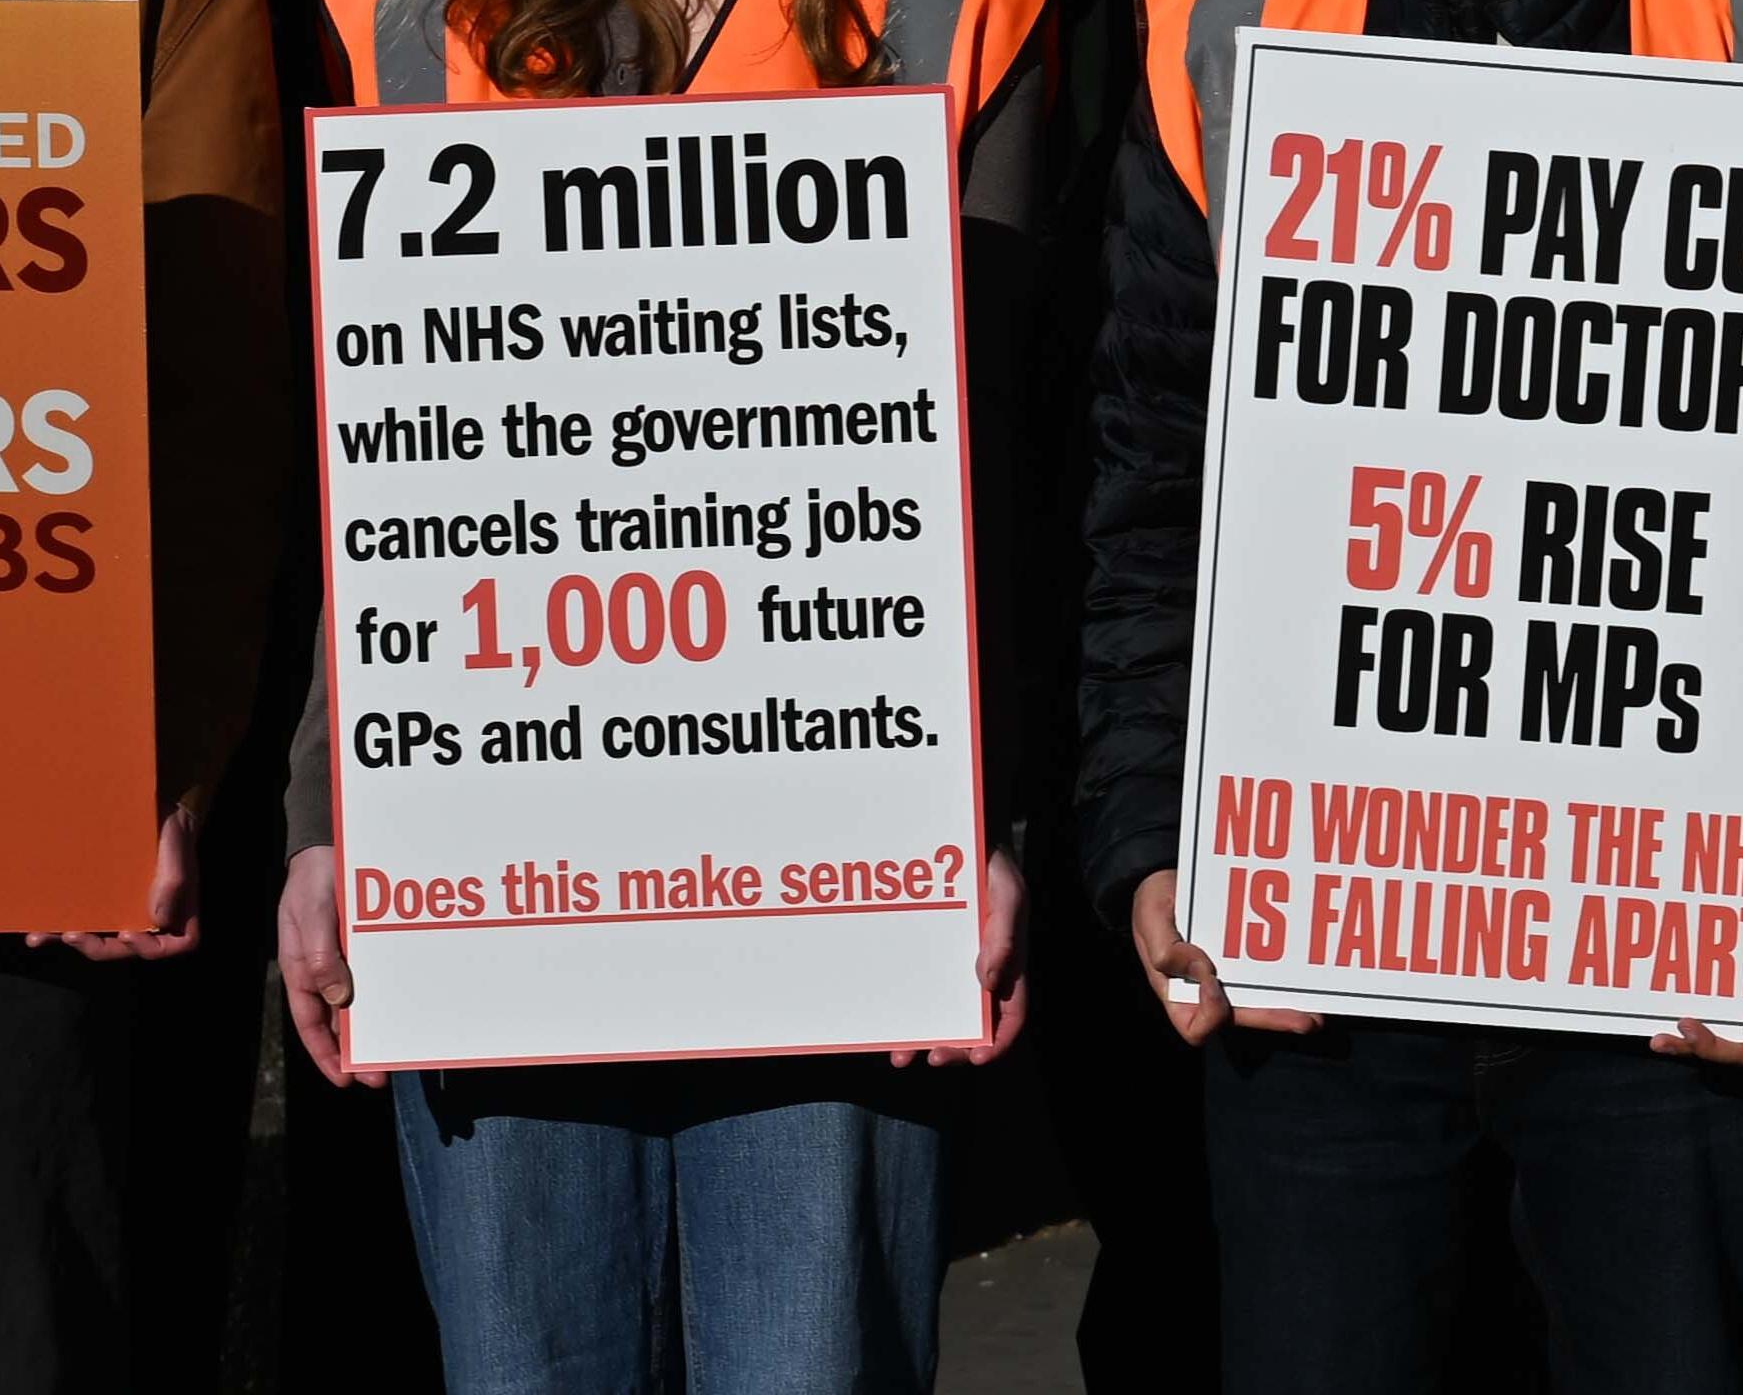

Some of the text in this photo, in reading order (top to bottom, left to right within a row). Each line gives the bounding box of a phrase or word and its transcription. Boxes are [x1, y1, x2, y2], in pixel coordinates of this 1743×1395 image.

[0, 112, 86, 169] ED
[320, 132, 910, 261] 7.2 million
[1264, 132, 1453, 272] 21%
[1480, 150, 1643, 284] PAY
[336, 291, 909, 368] on NHS waiting lists,
[1253, 276, 1415, 410] FOR
[339, 389, 938, 467] while the government
[344, 486, 922, 562] cancels training jobs
[1346, 466, 1711, 616] 5% RISE
[355, 569, 925, 688] for 1,000 future
[1333, 605, 1703, 754] FOR MPs
[352, 694, 940, 769] GPs and consultants.
[354, 844, 966, 922] Does this make sense?
[1214, 776, 1290, 859] NO
[1309, 782, 1550, 880] WONDER
[1568, 802, 1663, 890] THE
[1222, 868, 1290, 962] IS
[1309, 874, 1549, 983] FALLING
